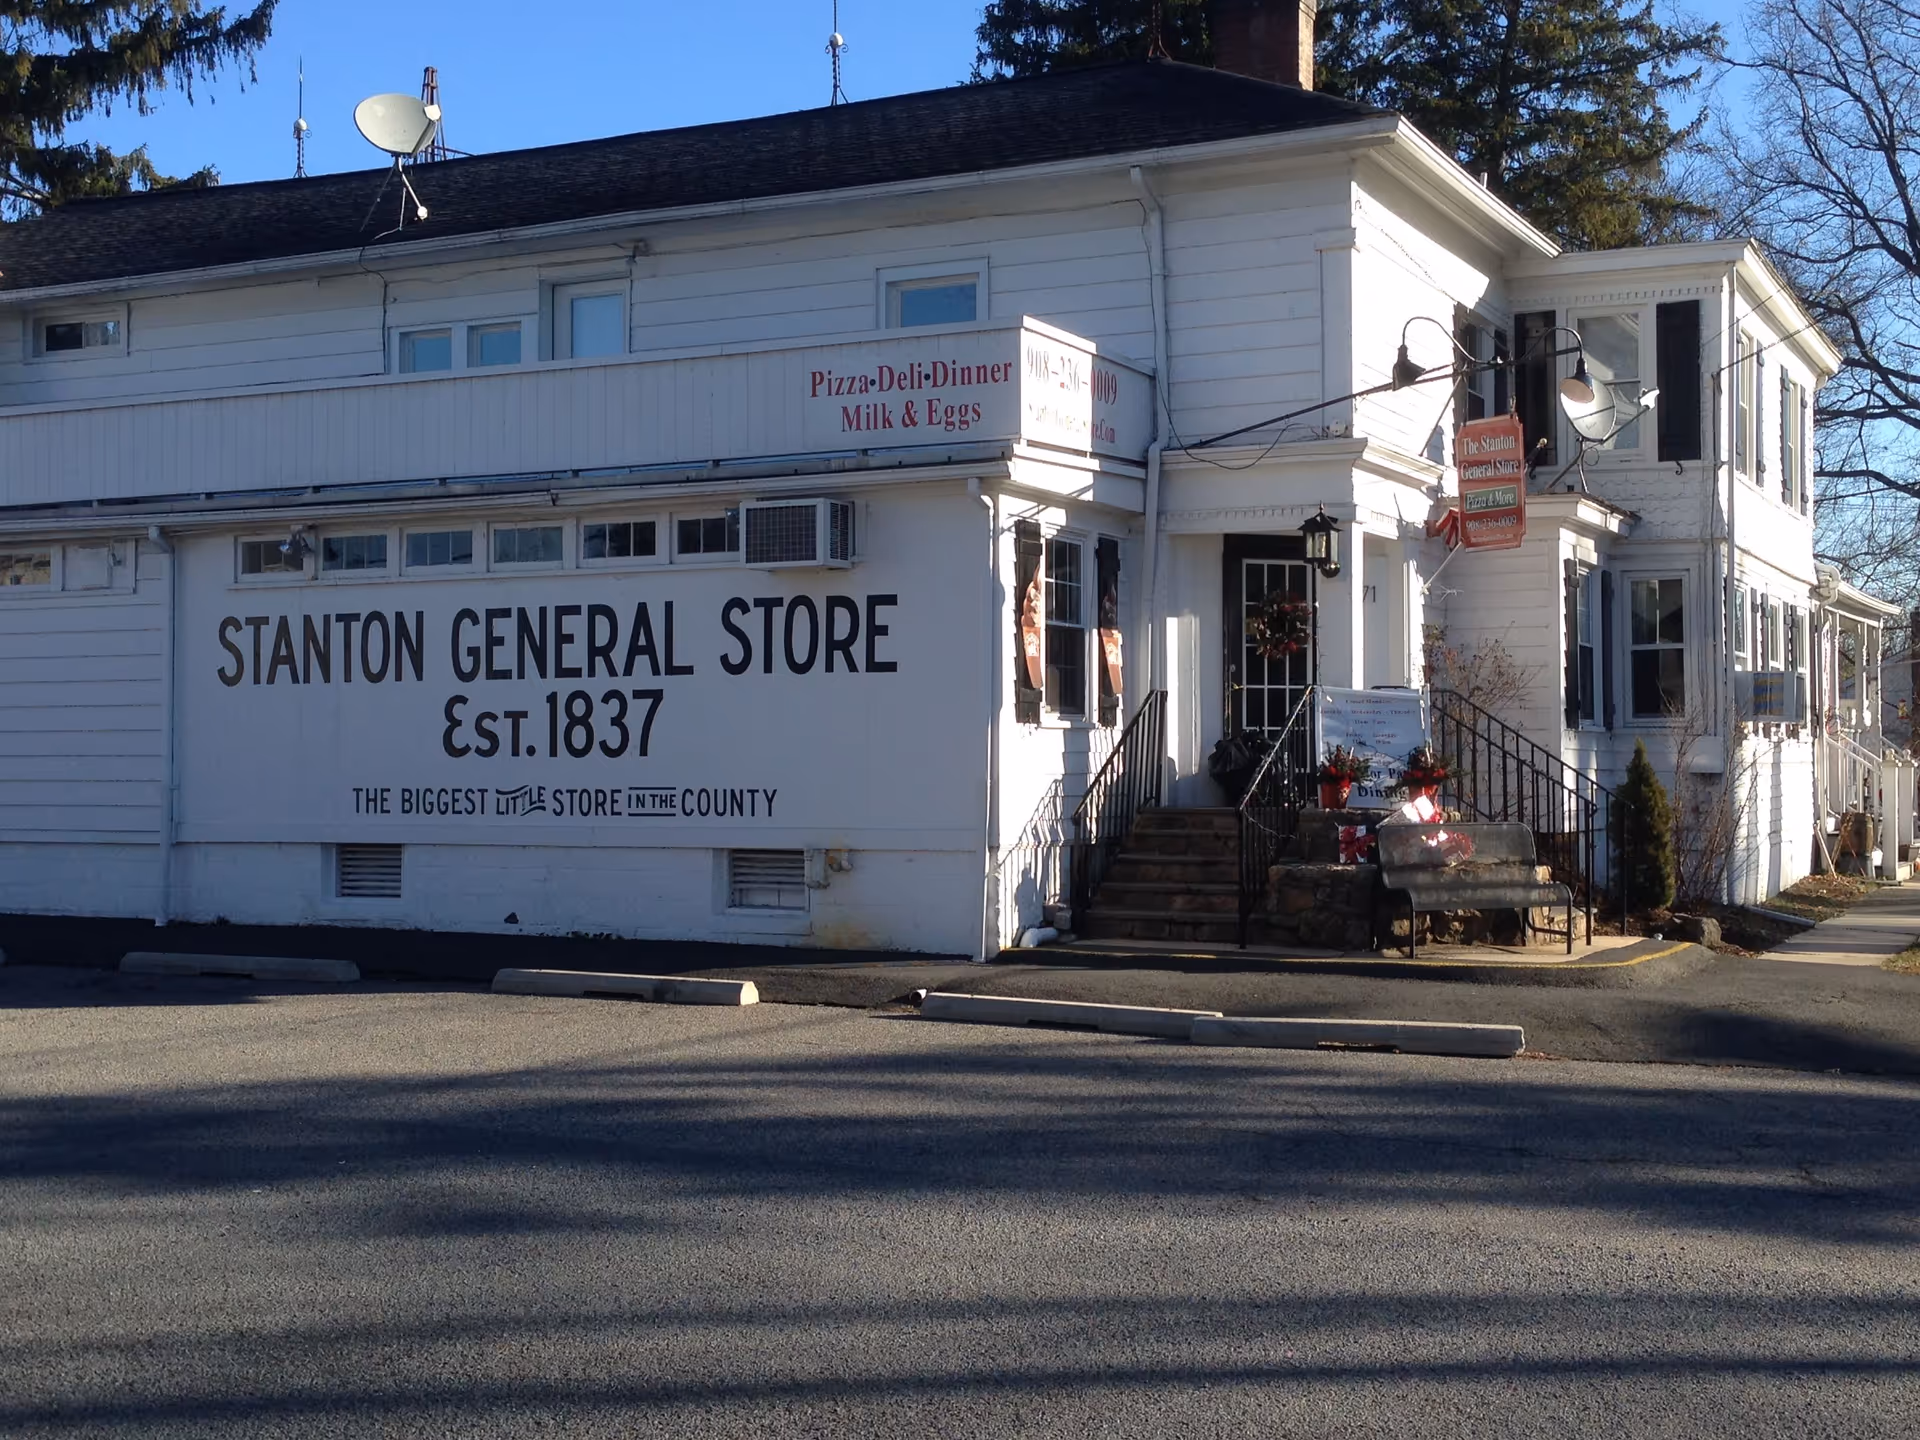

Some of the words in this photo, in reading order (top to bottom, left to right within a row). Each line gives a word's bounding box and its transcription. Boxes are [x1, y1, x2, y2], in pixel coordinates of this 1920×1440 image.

[841, 403, 893, 432] Milk
[901, 399, 919, 428] &
[927, 398, 981, 432] Eggs
[1462, 437, 1479, 455] The
[1480, 434, 1516, 454] Stanton
[1461, 459, 1494, 481] General
[1495, 457, 1519, 477] Store
[1466, 492, 1485, 509] Pizza
[1495, 490, 1514, 506] More
[217, 611, 424, 688] STANTON
[451, 601, 695, 682] GENERAL
[719, 594, 899, 676] STORE
[353, 788, 391, 815] THE
[401, 788, 489, 816] BIGGEST
[496, 785, 547, 817] LITTLE
[552, 788, 623, 817] STORE
[628, 793, 646, 809] IN
[649, 793, 677, 809] THE
[681, 788, 778, 817] COUNTY
